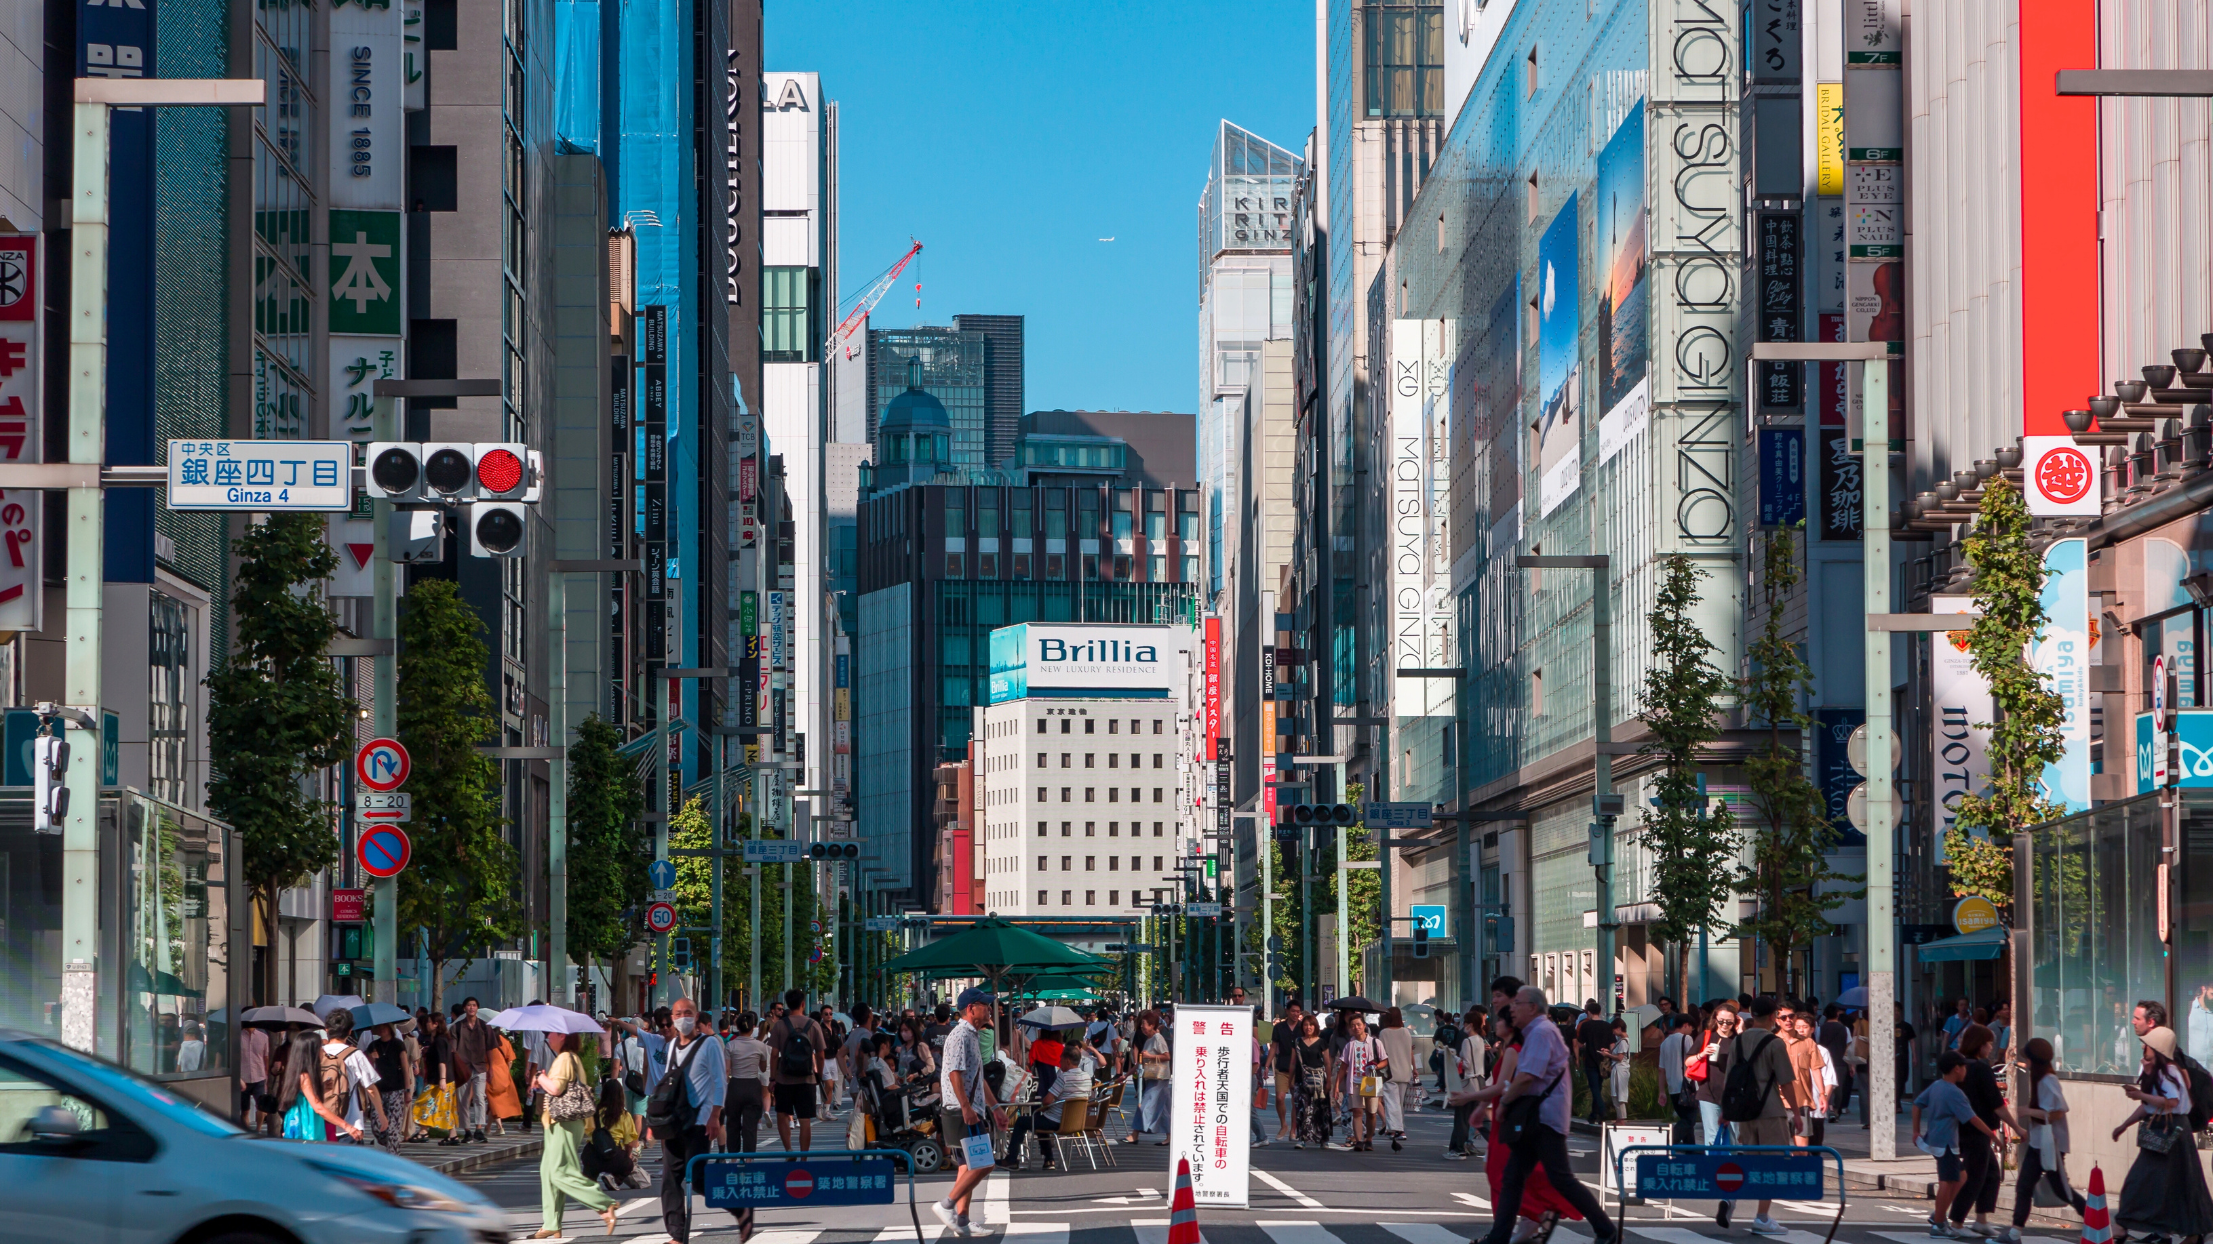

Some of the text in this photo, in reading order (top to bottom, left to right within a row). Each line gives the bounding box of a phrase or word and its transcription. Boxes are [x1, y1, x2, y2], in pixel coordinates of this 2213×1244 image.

[1865, 53, 1888, 63] 7F
[352, 46, 371, 178] SINCE 1885
[1821, 89, 1831, 188] BRIDAL GALLERY
[1866, 149, 1889, 160] 6F
[1764, 219, 1778, 276] 中国料理
[1867, 246, 1890, 257] 5F
[332, 231, 392, 314] 本
[656, 310, 664, 352] MATSUZAWA
[741, 433, 755, 441] TCB
[181, 442, 231, 456] 中央区
[181, 459, 338, 487] 銀座四丁目
[227, 487, 290, 504] Ginza 4
[1764, 504, 1773, 522] 銀座
[1039, 639, 1159, 662] Brillia
[1040, 665, 1157, 674] NEW LUXURY RESIDENCE
[1264, 653, 1273, 694] KDI-HOME
[744, 680, 752, 725] I-PRIMO
[1208, 673, 1218, 738] 銀座アスター
[1369, 808, 1428, 820] 銀座三丁目
[747, 845, 798, 855] 銀座三丁目
[334, 894, 364, 903] BOOKS
[653, 911, 670, 924] 50
[1192, 1021, 1235, 1036] 警 告
[1214, 1046, 1231, 1170] 歩行者天国での自転車の
[1192, 1046, 1208, 1188] 乗り入れは禁止されています。
[1656, 1163, 1697, 1176] 自転車
[725, 1172, 766, 1186] 自転車
[817, 1175, 887, 1190] 築地警察署
[1643, 1177, 1711, 1192] 乗入れ禁止
[1748, 1171, 1817, 1185] 築地警察署
[712, 1186, 780, 1200] 乗入れ禁止
[1194, 1190, 1230, 1198] 地警察署長
